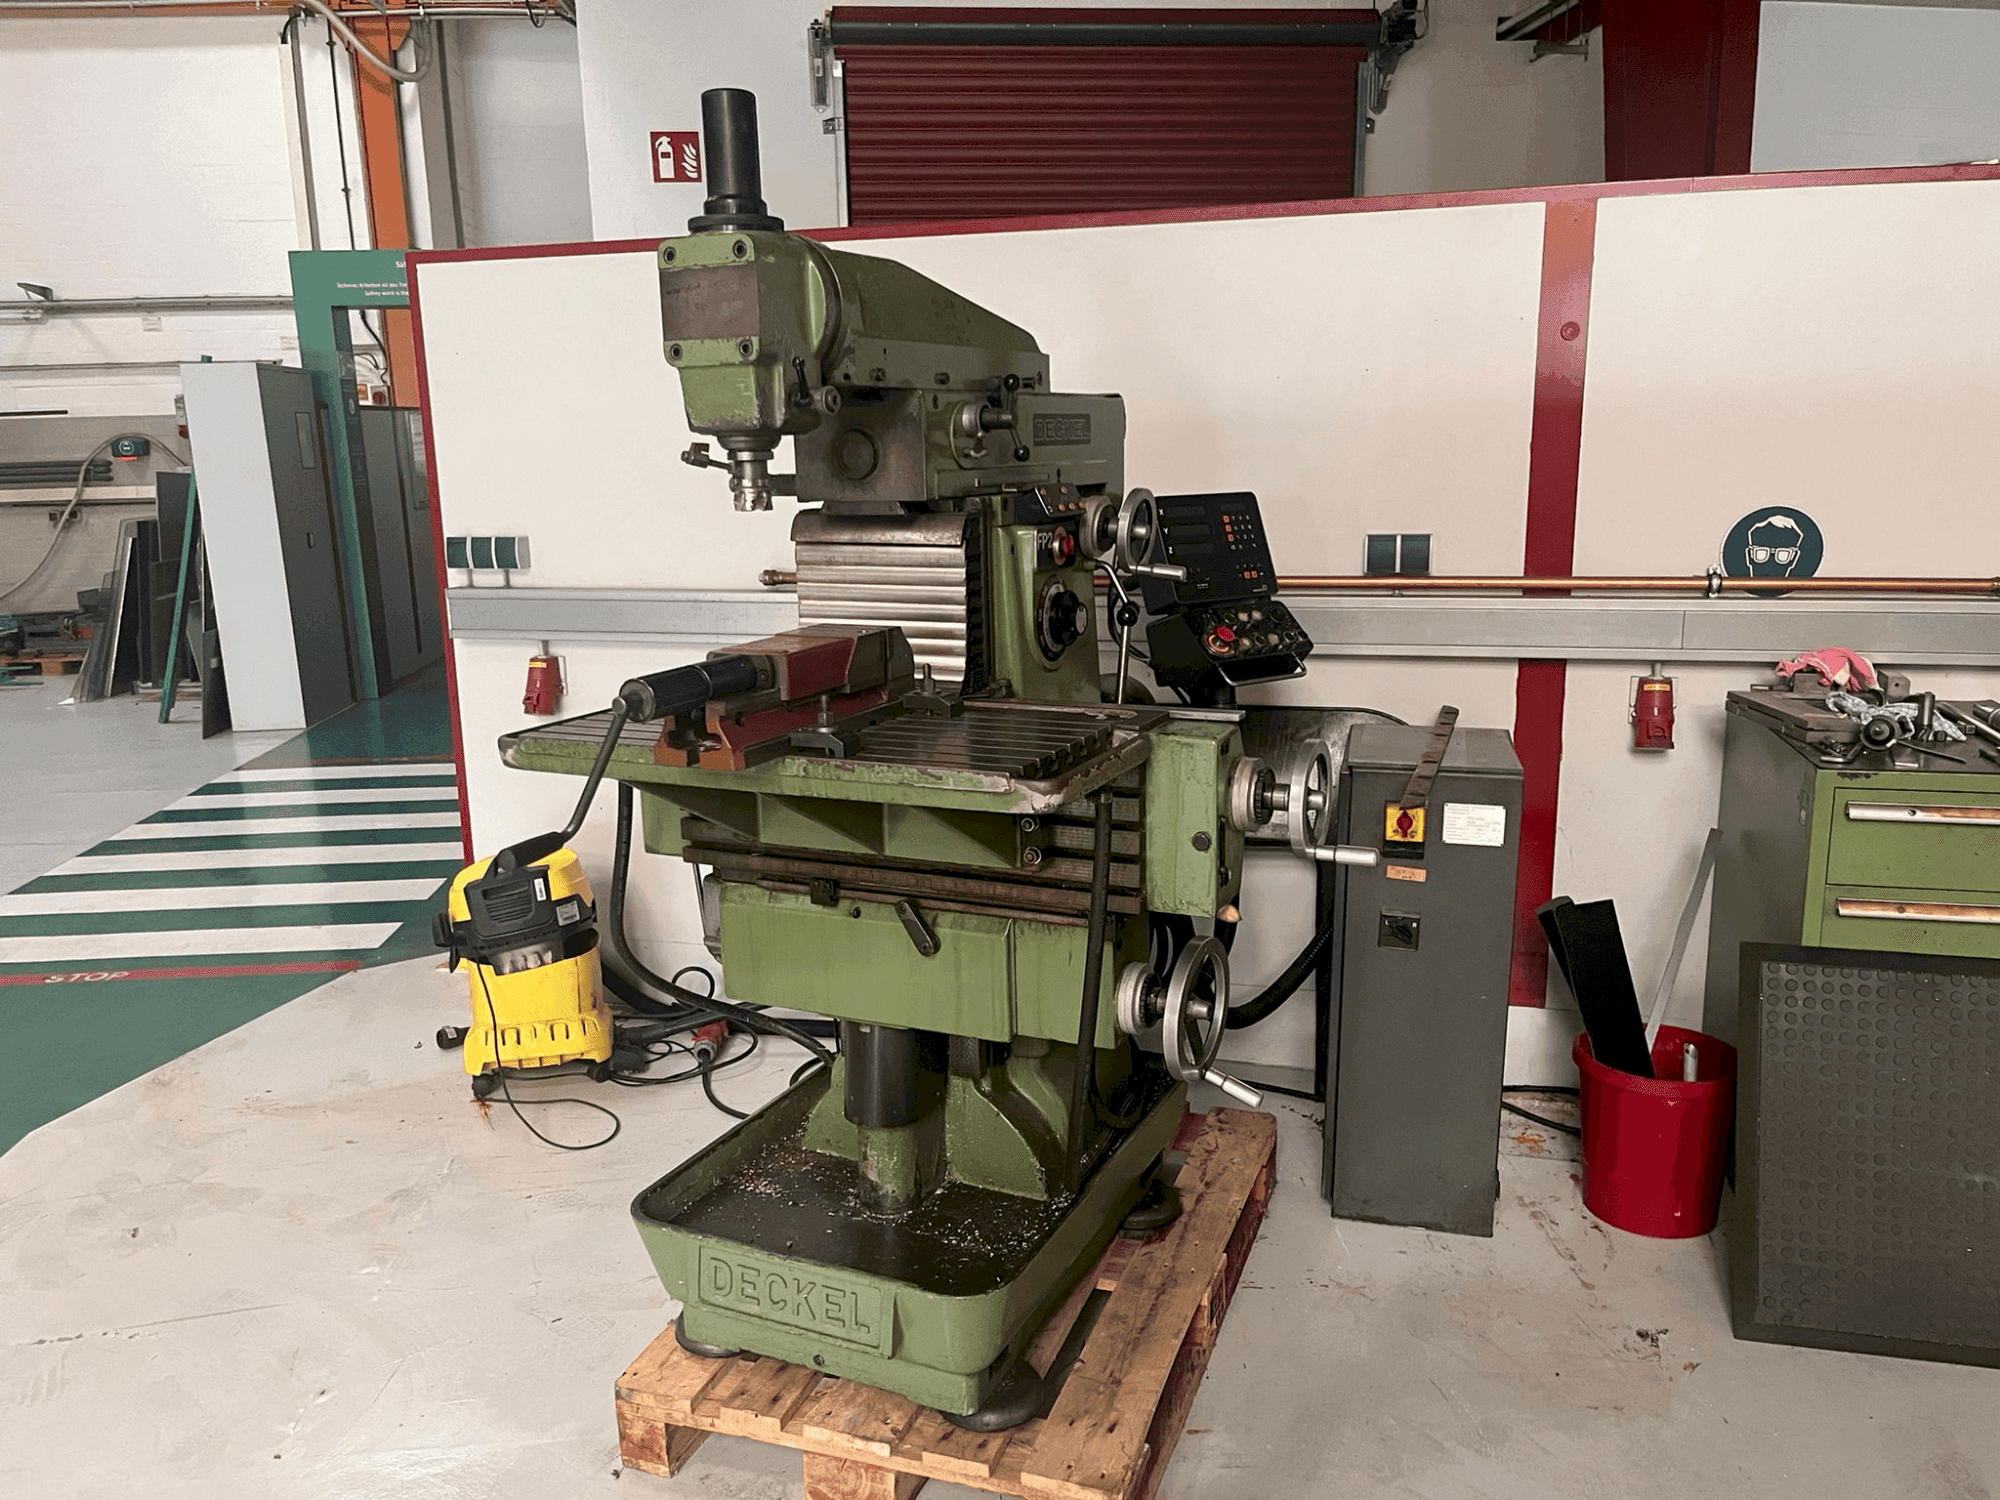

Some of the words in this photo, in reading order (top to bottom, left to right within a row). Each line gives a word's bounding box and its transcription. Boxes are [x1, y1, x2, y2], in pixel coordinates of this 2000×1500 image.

[1034, 417, 1090, 441] DECKEL
[1158, 508, 1164, 516] X
[1037, 532, 1053, 550] FP2
[1168, 546, 1173, 554] Z
[45, 971, 129, 983] STOP
[709, 1256, 871, 1334] DECKEL
